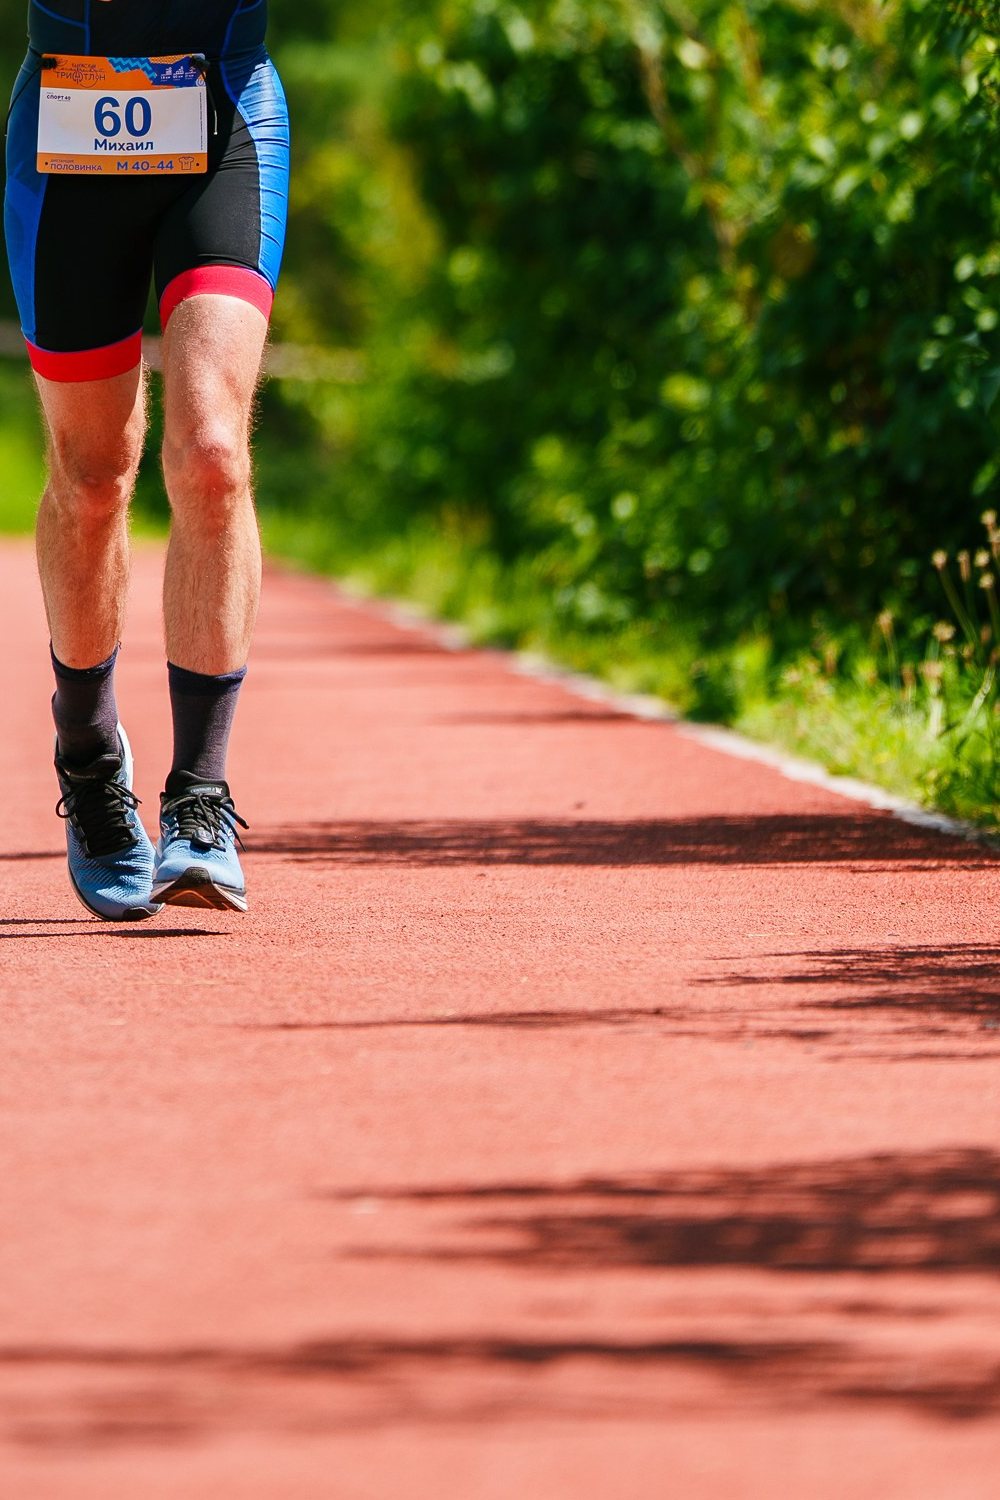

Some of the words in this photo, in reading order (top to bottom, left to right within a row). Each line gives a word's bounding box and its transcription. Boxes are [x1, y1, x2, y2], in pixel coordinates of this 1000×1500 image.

[94, 96, 152, 137] 60
[94, 138, 154, 151] Михаил
[50, 163, 103, 171] ПОЛОВИНКА
[131, 160, 174, 171] 40-44
